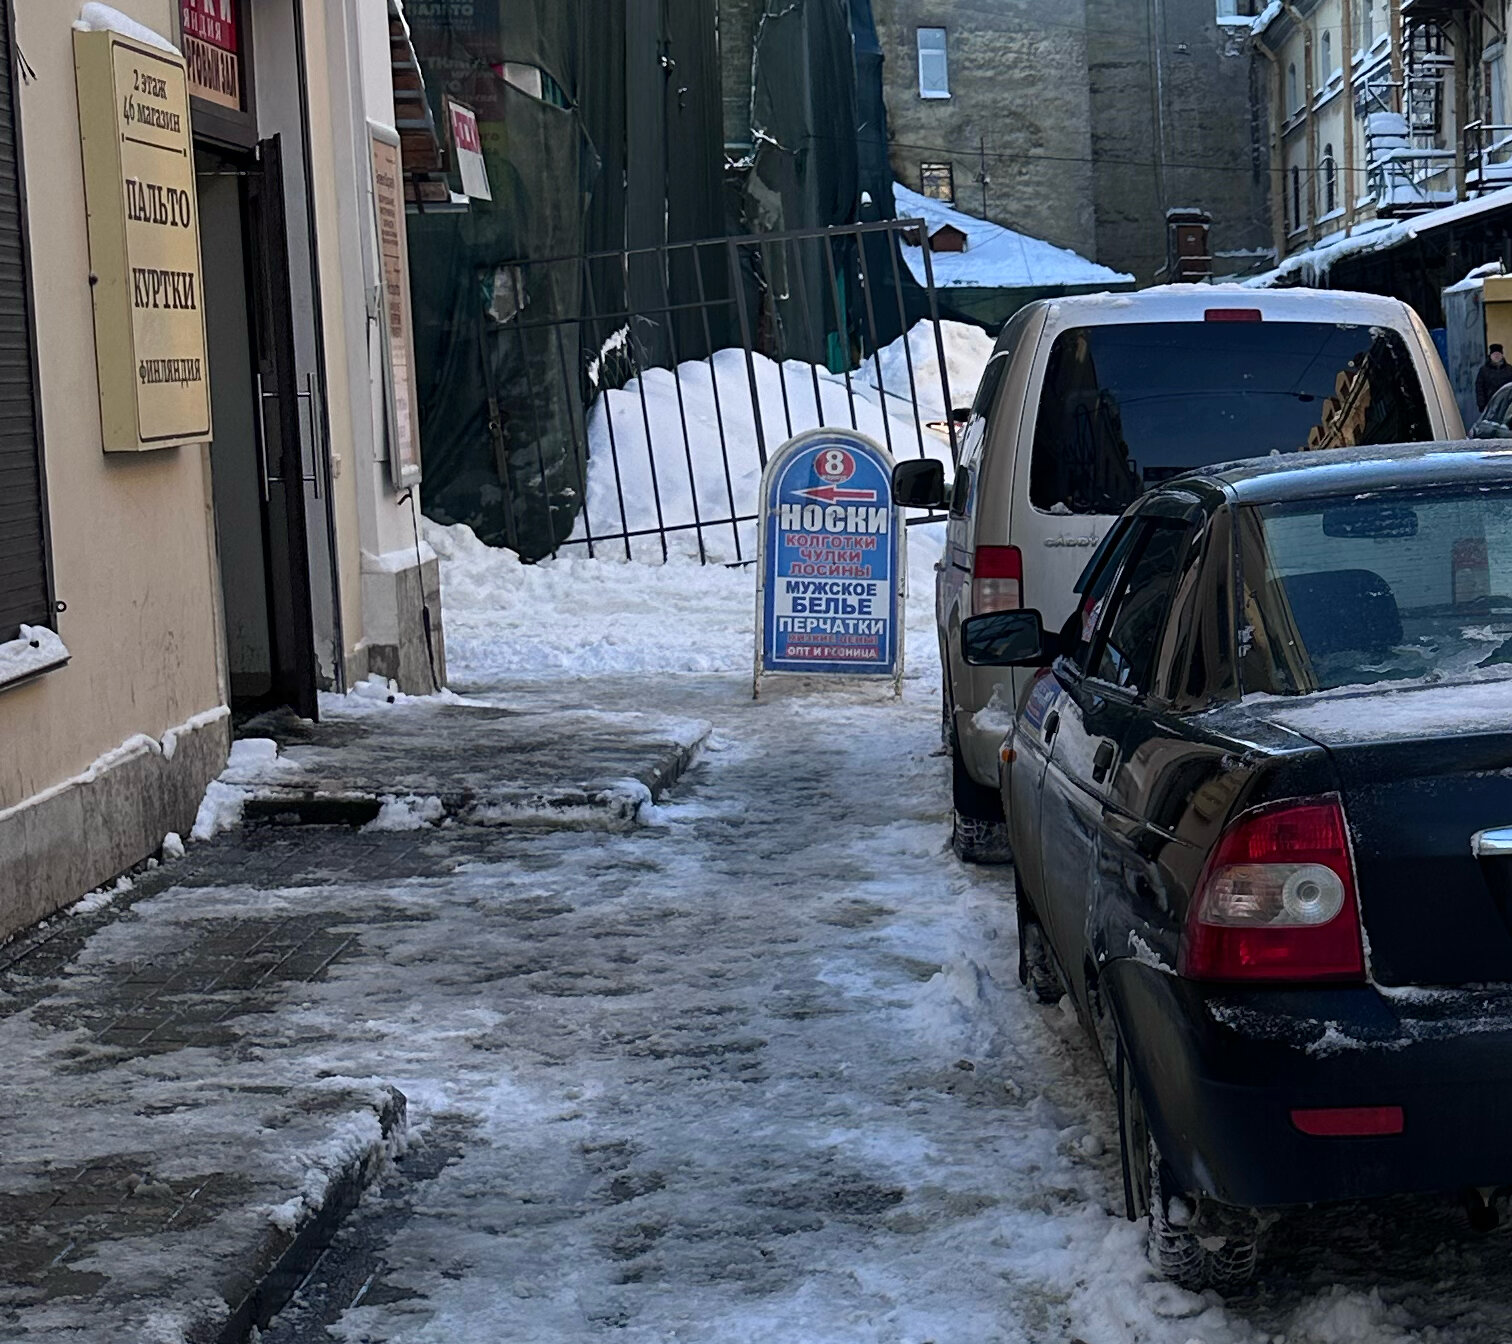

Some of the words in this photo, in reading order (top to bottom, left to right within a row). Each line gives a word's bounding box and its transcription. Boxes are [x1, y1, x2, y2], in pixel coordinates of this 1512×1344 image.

[133, 69, 139, 91] 2
[123, 94, 135, 126] 46
[126, 179, 190, 228] ПАЛЬТО
[132, 268, 197, 309] КУРТКИ
[825, 450, 844, 475] 8
[780, 503, 888, 534] НОСКИ
[785, 534, 877, 550] КОЛГОТКИ
[1043, 536, 1100, 548] CADDY
[799, 549, 862, 564] ЧУЛКИ
[789, 562, 872, 578] ЛОСИНЫ
[785, 580, 878, 597] МУЖСКОЕ
[791, 596, 873, 616] БЕЛЬЕ
[779, 617, 885, 635] ПЕРЧАТКИ
[787, 646, 811, 657] ОПТ
[813, 647, 822, 657] И
